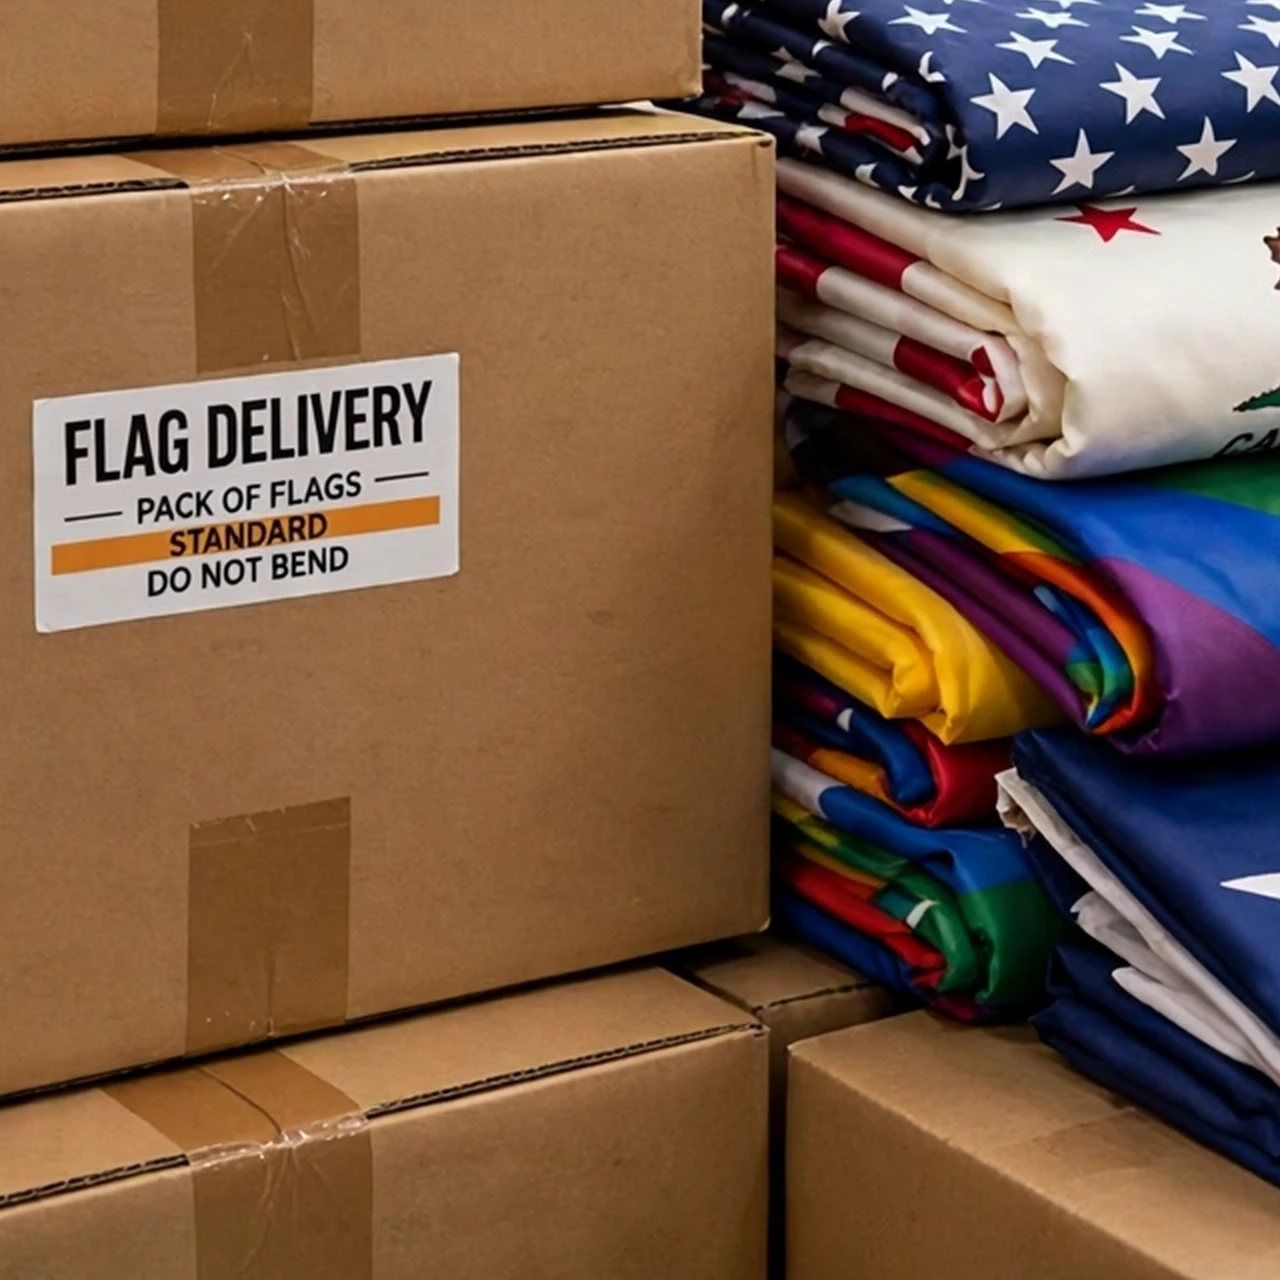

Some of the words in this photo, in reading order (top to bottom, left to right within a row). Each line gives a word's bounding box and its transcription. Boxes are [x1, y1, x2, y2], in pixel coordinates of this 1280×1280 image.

[65, 409, 189, 486] FLAG
[208, 380, 432, 469] DELIVERY
[137, 490, 213, 525] PACK
[222, 484, 261, 514] OF
[270, 471, 361, 509] FLAGS
[171, 514, 326, 556] STANDARD
[148, 566, 192, 597] DO
[201, 556, 263, 589] NOT
[272, 546, 349, 580] BEND
